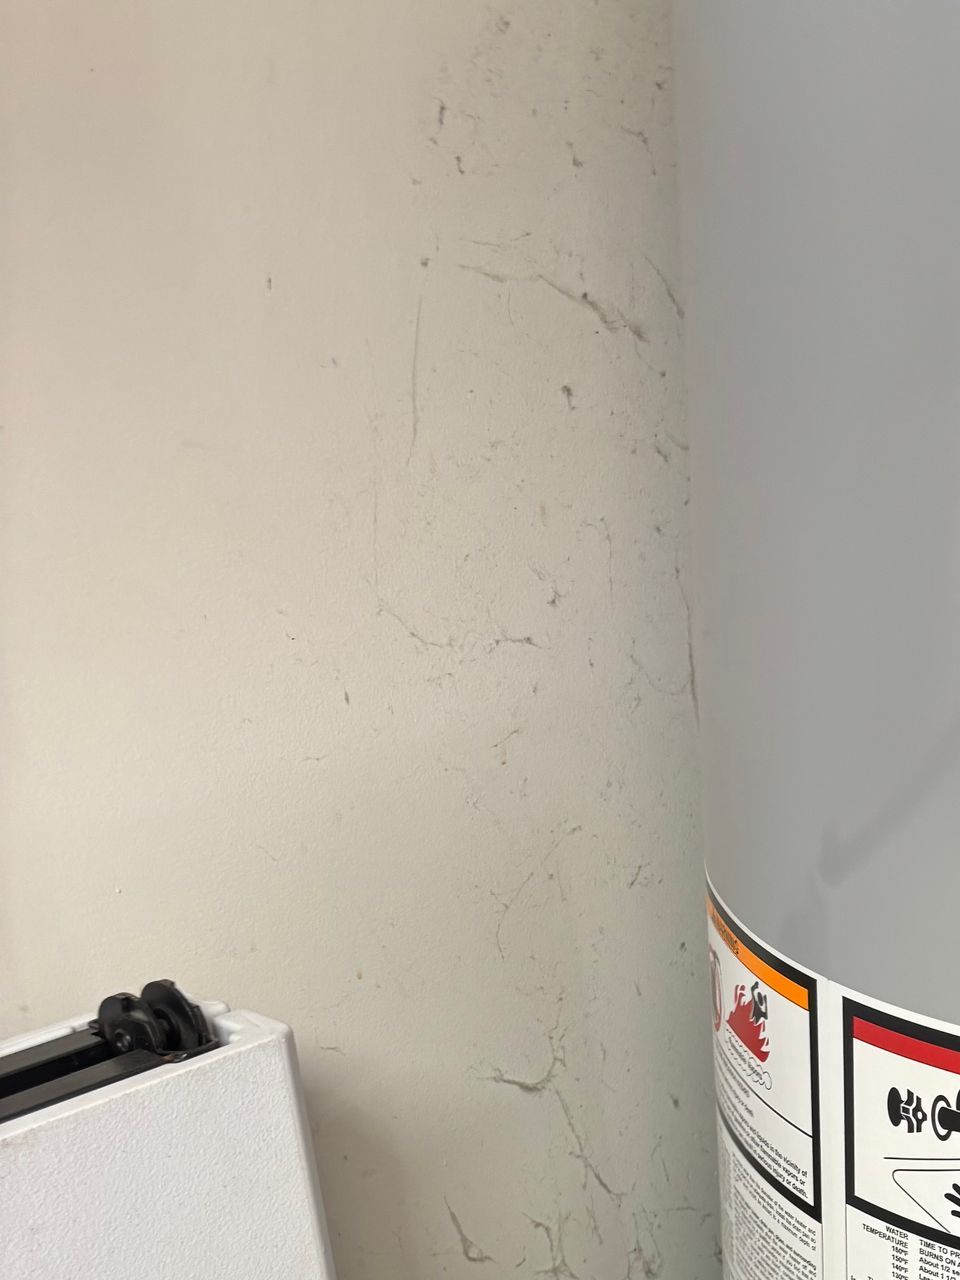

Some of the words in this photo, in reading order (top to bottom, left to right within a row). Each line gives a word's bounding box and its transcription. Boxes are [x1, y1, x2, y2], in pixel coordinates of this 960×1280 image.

[862, 1223, 909, 1249] TEMPERATURE
[885, 1225, 909, 1241] WATER
[919, 1238, 936, 1251] TIME
[937, 1245, 949, 1255] TO
[918, 1256, 940, 1270] About
[940, 1264, 951, 1273] 1/2
[919, 1247, 944, 1263] BURNS
[944, 1257, 957, 1267] ON
